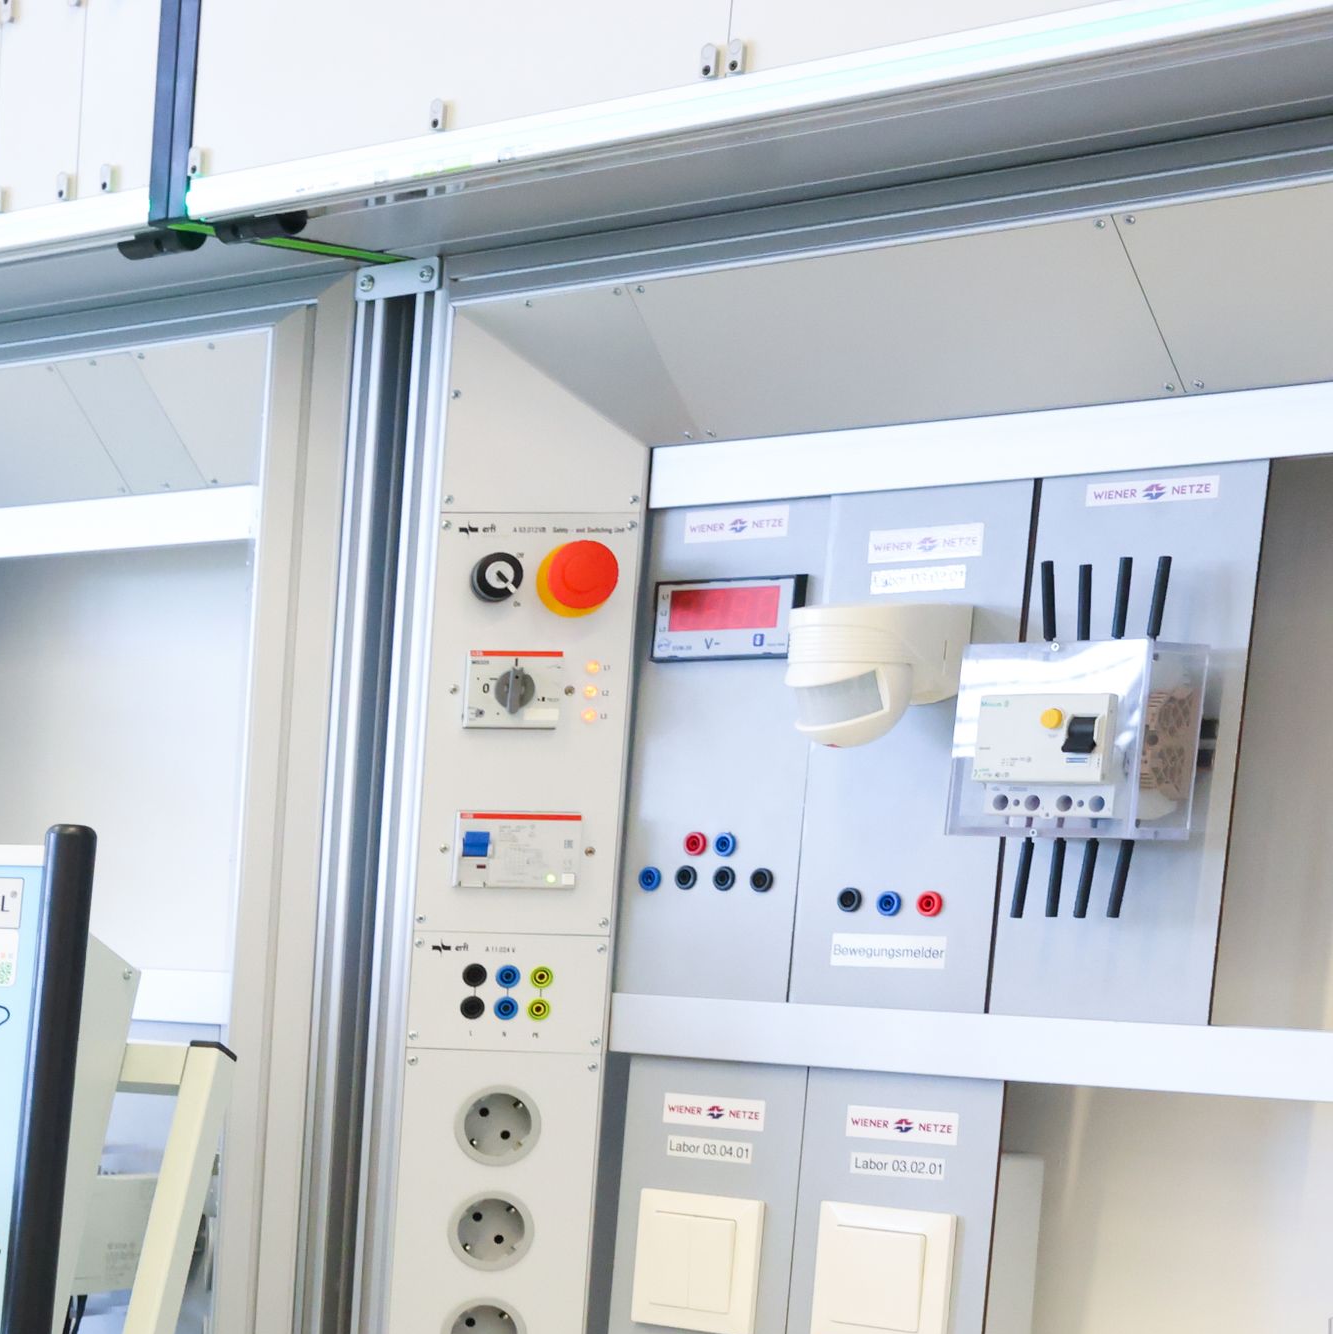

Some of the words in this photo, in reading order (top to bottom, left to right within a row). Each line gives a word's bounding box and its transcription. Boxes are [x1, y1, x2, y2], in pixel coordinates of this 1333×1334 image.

[1093, 489, 1137, 502] WIENER
[1171, 482, 1212, 496] NETZE
[689, 522, 725, 534] WIENER
[752, 517, 784, 529] NETZE
[873, 540, 912, 553] WIENER
[942, 534, 979, 549] NETZE
[832, 943, 945, 961] Bewegungsmelder
[668, 1104, 702, 1116] WIENER
[729, 1109, 760, 1121] NETZE
[851, 1116, 889, 1130] WIENER
[918, 1121, 953, 1134] NETZE
[669, 1140, 700, 1155] Labor
[703, 1143, 750, 1159] 03.04.01
[854, 1157, 888, 1172] Labor
[891, 1160, 944, 1176] 03.02.01
